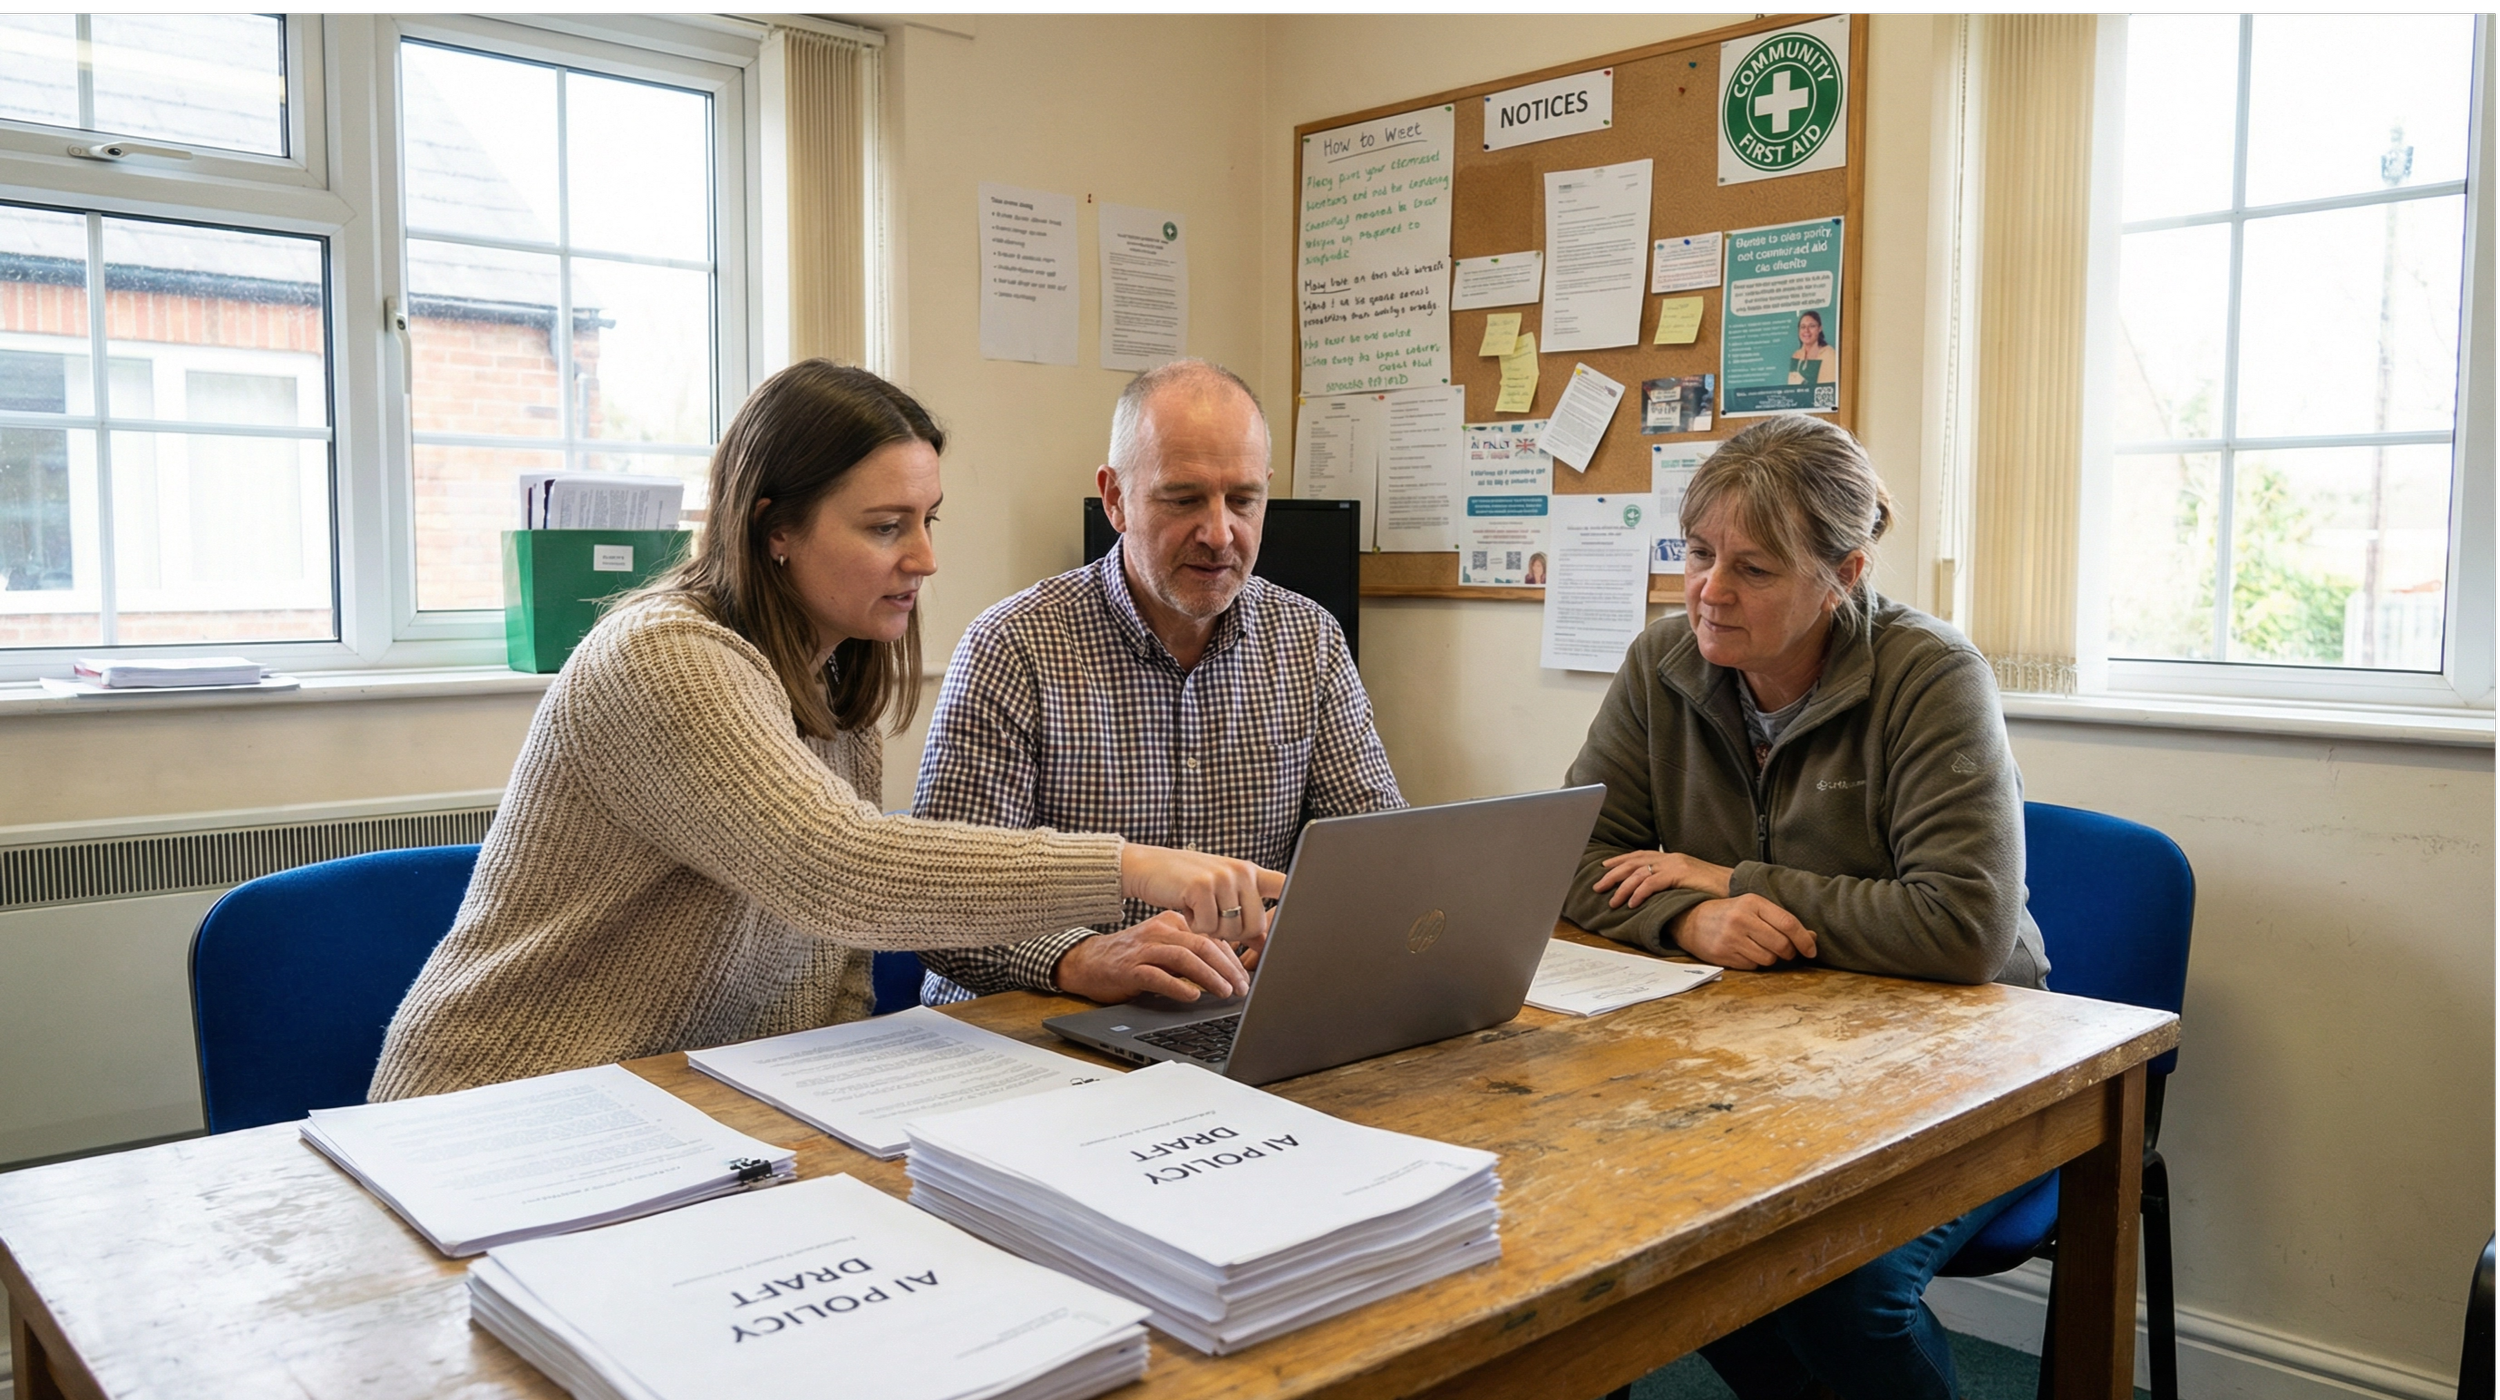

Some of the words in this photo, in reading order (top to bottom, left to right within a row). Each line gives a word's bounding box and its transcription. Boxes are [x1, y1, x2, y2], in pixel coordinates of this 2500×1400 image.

[1734, 41, 1834, 98] COMMUNITY
[1500, 90, 1588, 129] NOTICES
[1324, 138, 1351, 157] How
[1360, 131, 1375, 148] to
[1738, 133, 1786, 163] FIRST
[1792, 124, 1821, 159] AID
[1130, 1126, 1239, 1162] DRAFT
[1263, 1134, 1299, 1153] AI
[1145, 1147, 1266, 1185] POLICY
[731, 1258, 872, 1309] DRAFT
[895, 1270, 938, 1294] AI
[731, 1286, 892, 1343] POLICY
